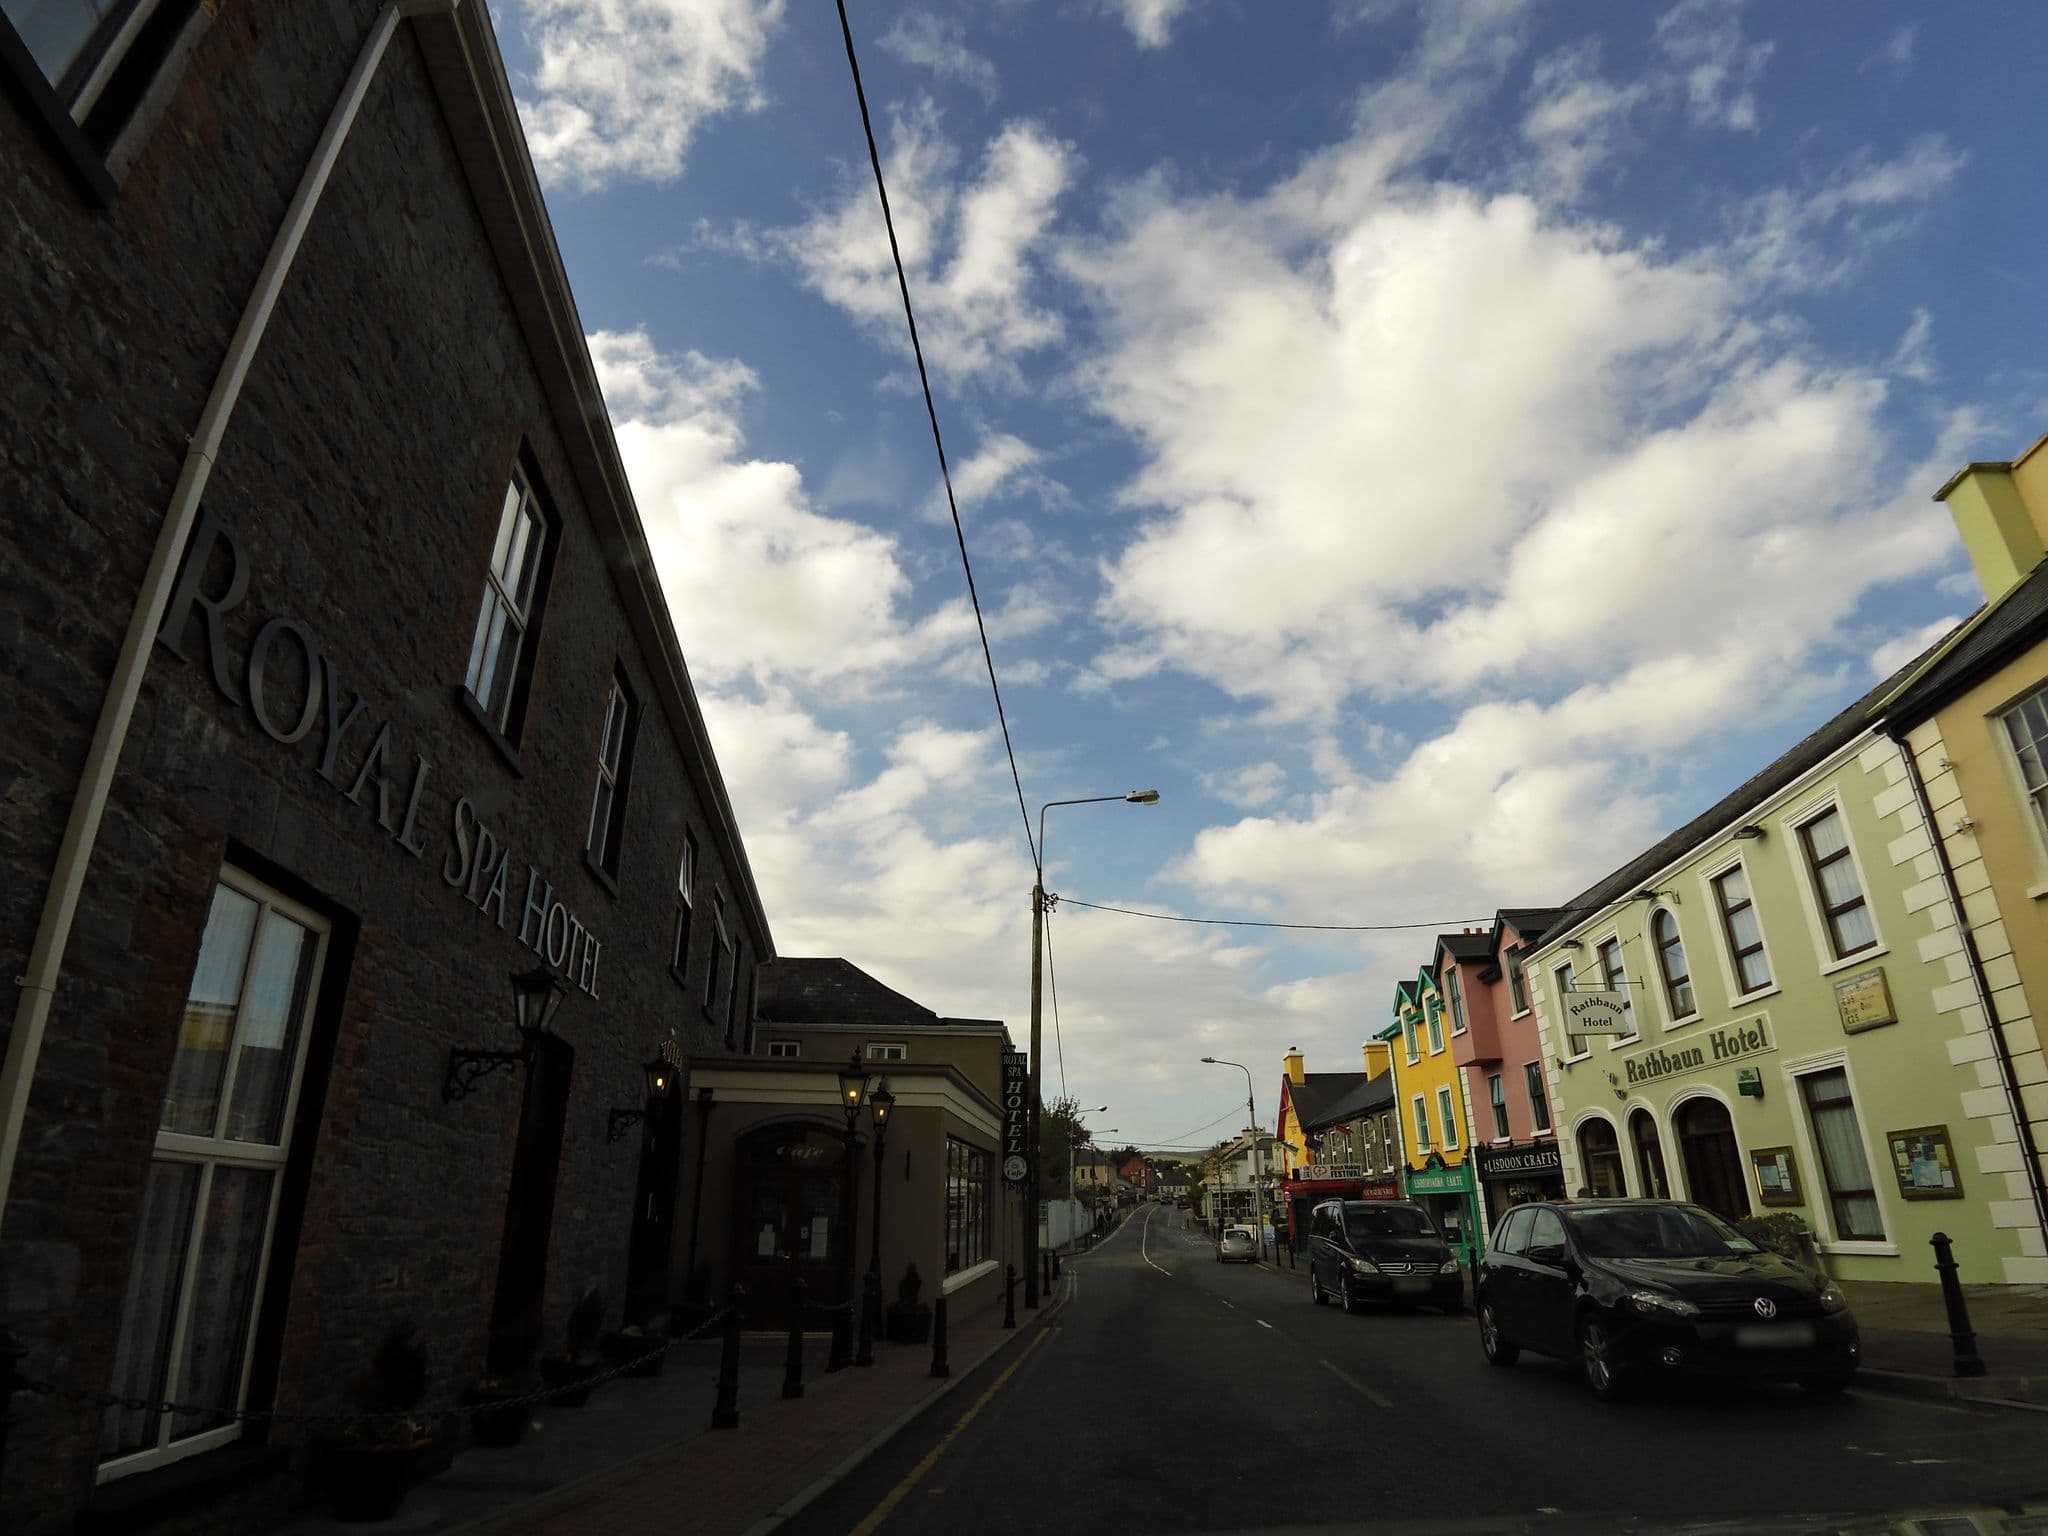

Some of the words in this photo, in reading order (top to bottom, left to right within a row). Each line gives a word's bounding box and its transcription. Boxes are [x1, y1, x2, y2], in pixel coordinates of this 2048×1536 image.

[156, 504, 433, 859] ROYAL
[441, 794, 511, 929] SPA
[516, 864, 603, 1001] HOTEL
[1570, 997, 1623, 1016] Rathbaun
[1582, 1016, 1613, 1027] Hotel
[1003, 1055, 1027, 1065] ROYAL
[1624, 1048, 1704, 1083] Rathbaun
[1709, 1018, 1768, 1060] Hotel
[1007, 1066, 1022, 1077] SPA
[1007, 1081, 1024, 1153] HOTEL
[1487, 1155, 1522, 1172] LISDOON
[1523, 1151, 1559, 1167] CRAFTS
[1330, 1170, 1361, 1178] FESTIVAL
